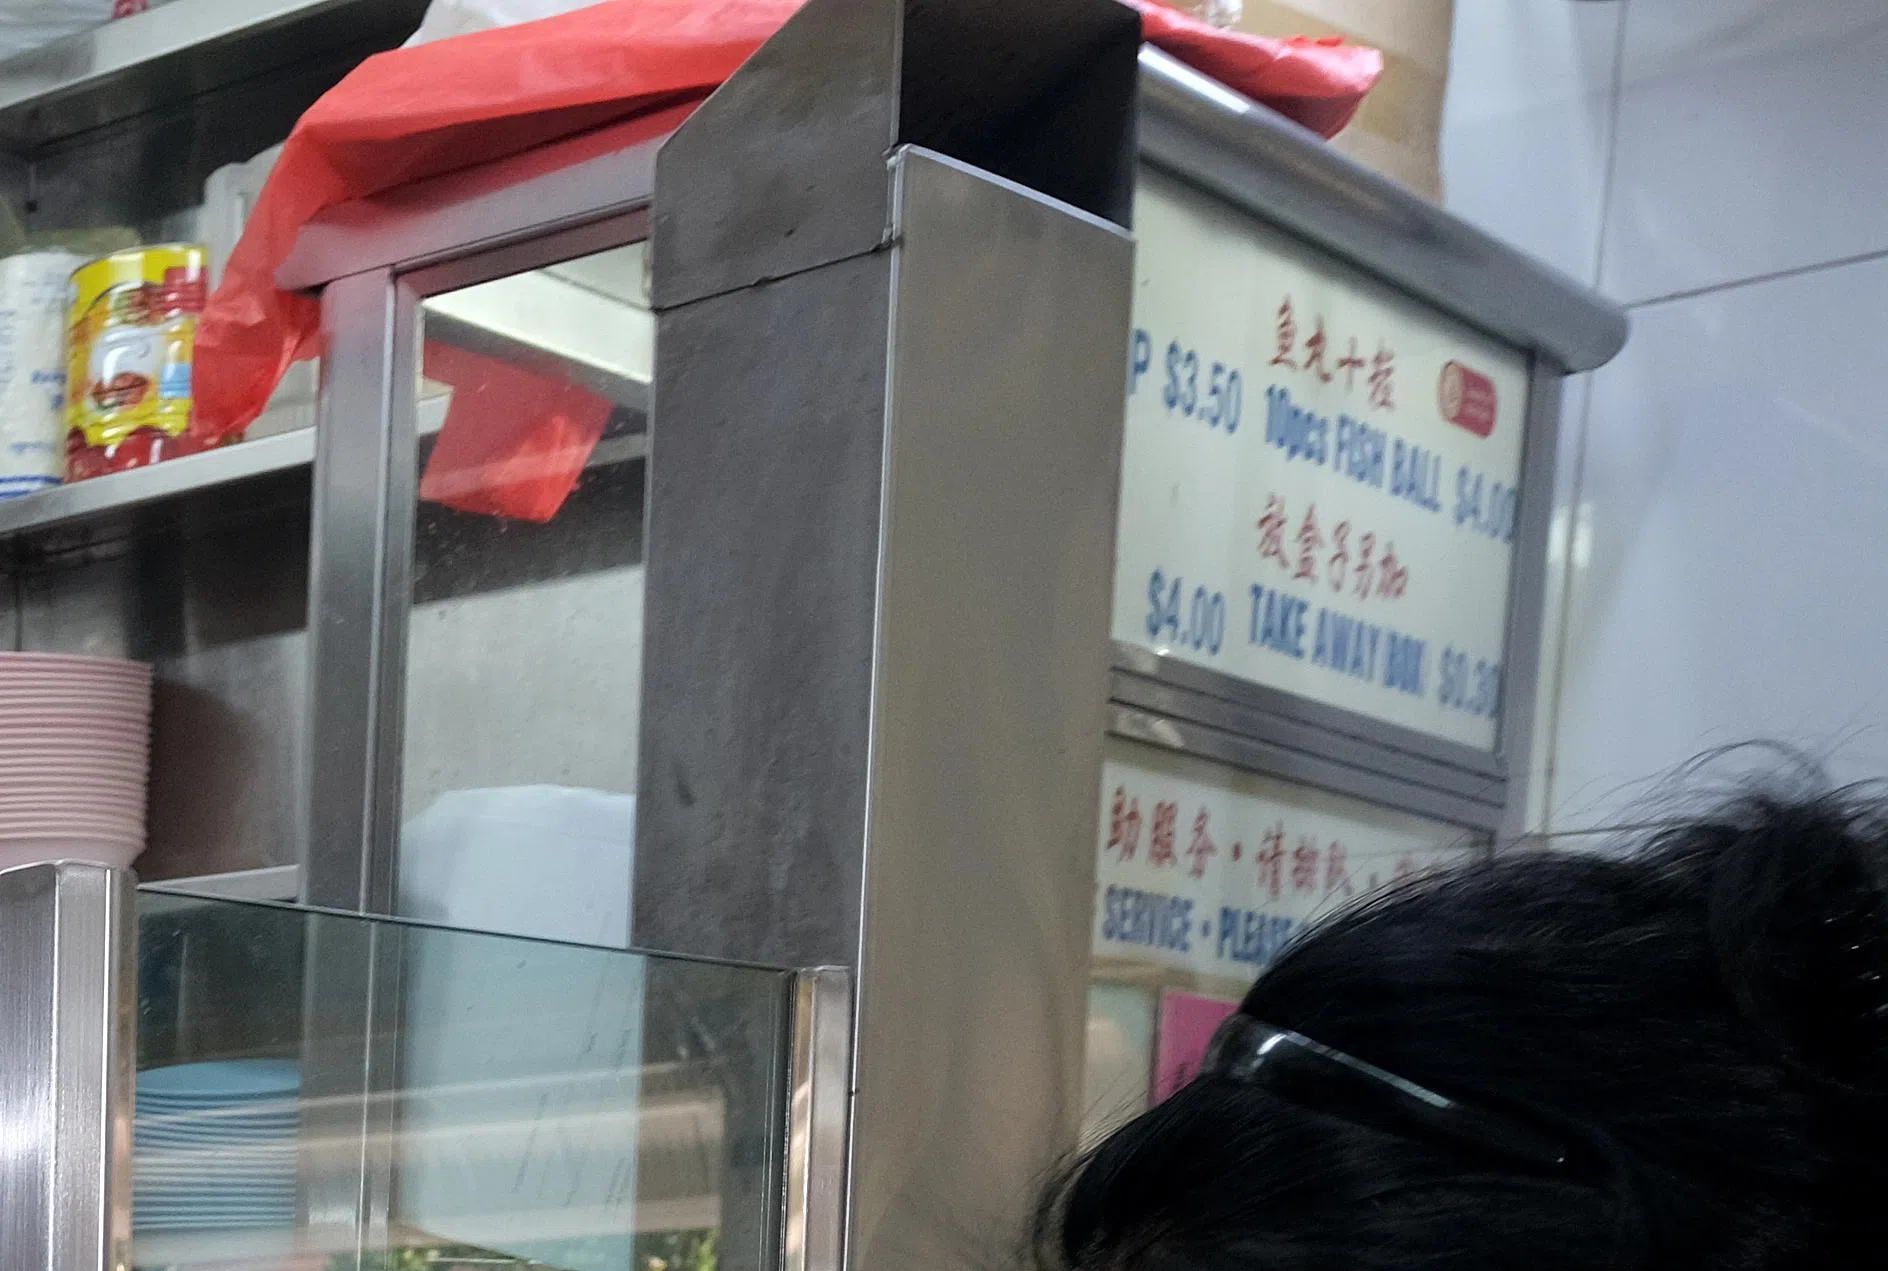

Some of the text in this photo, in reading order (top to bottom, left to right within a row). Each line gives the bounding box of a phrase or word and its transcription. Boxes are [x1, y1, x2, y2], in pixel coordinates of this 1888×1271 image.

[1164, 339, 1242, 435] $3.50
[1264, 384, 1328, 466] 10pcs
[1334, 413, 1387, 488] FISH
[1389, 436, 1442, 513] BALL
[1146, 568, 1225, 656] $4.00
[1249, 583, 1309, 660] TAKE
[1312, 607, 1380, 682] AWAY
[1103, 884, 1194, 953] SERVICE
